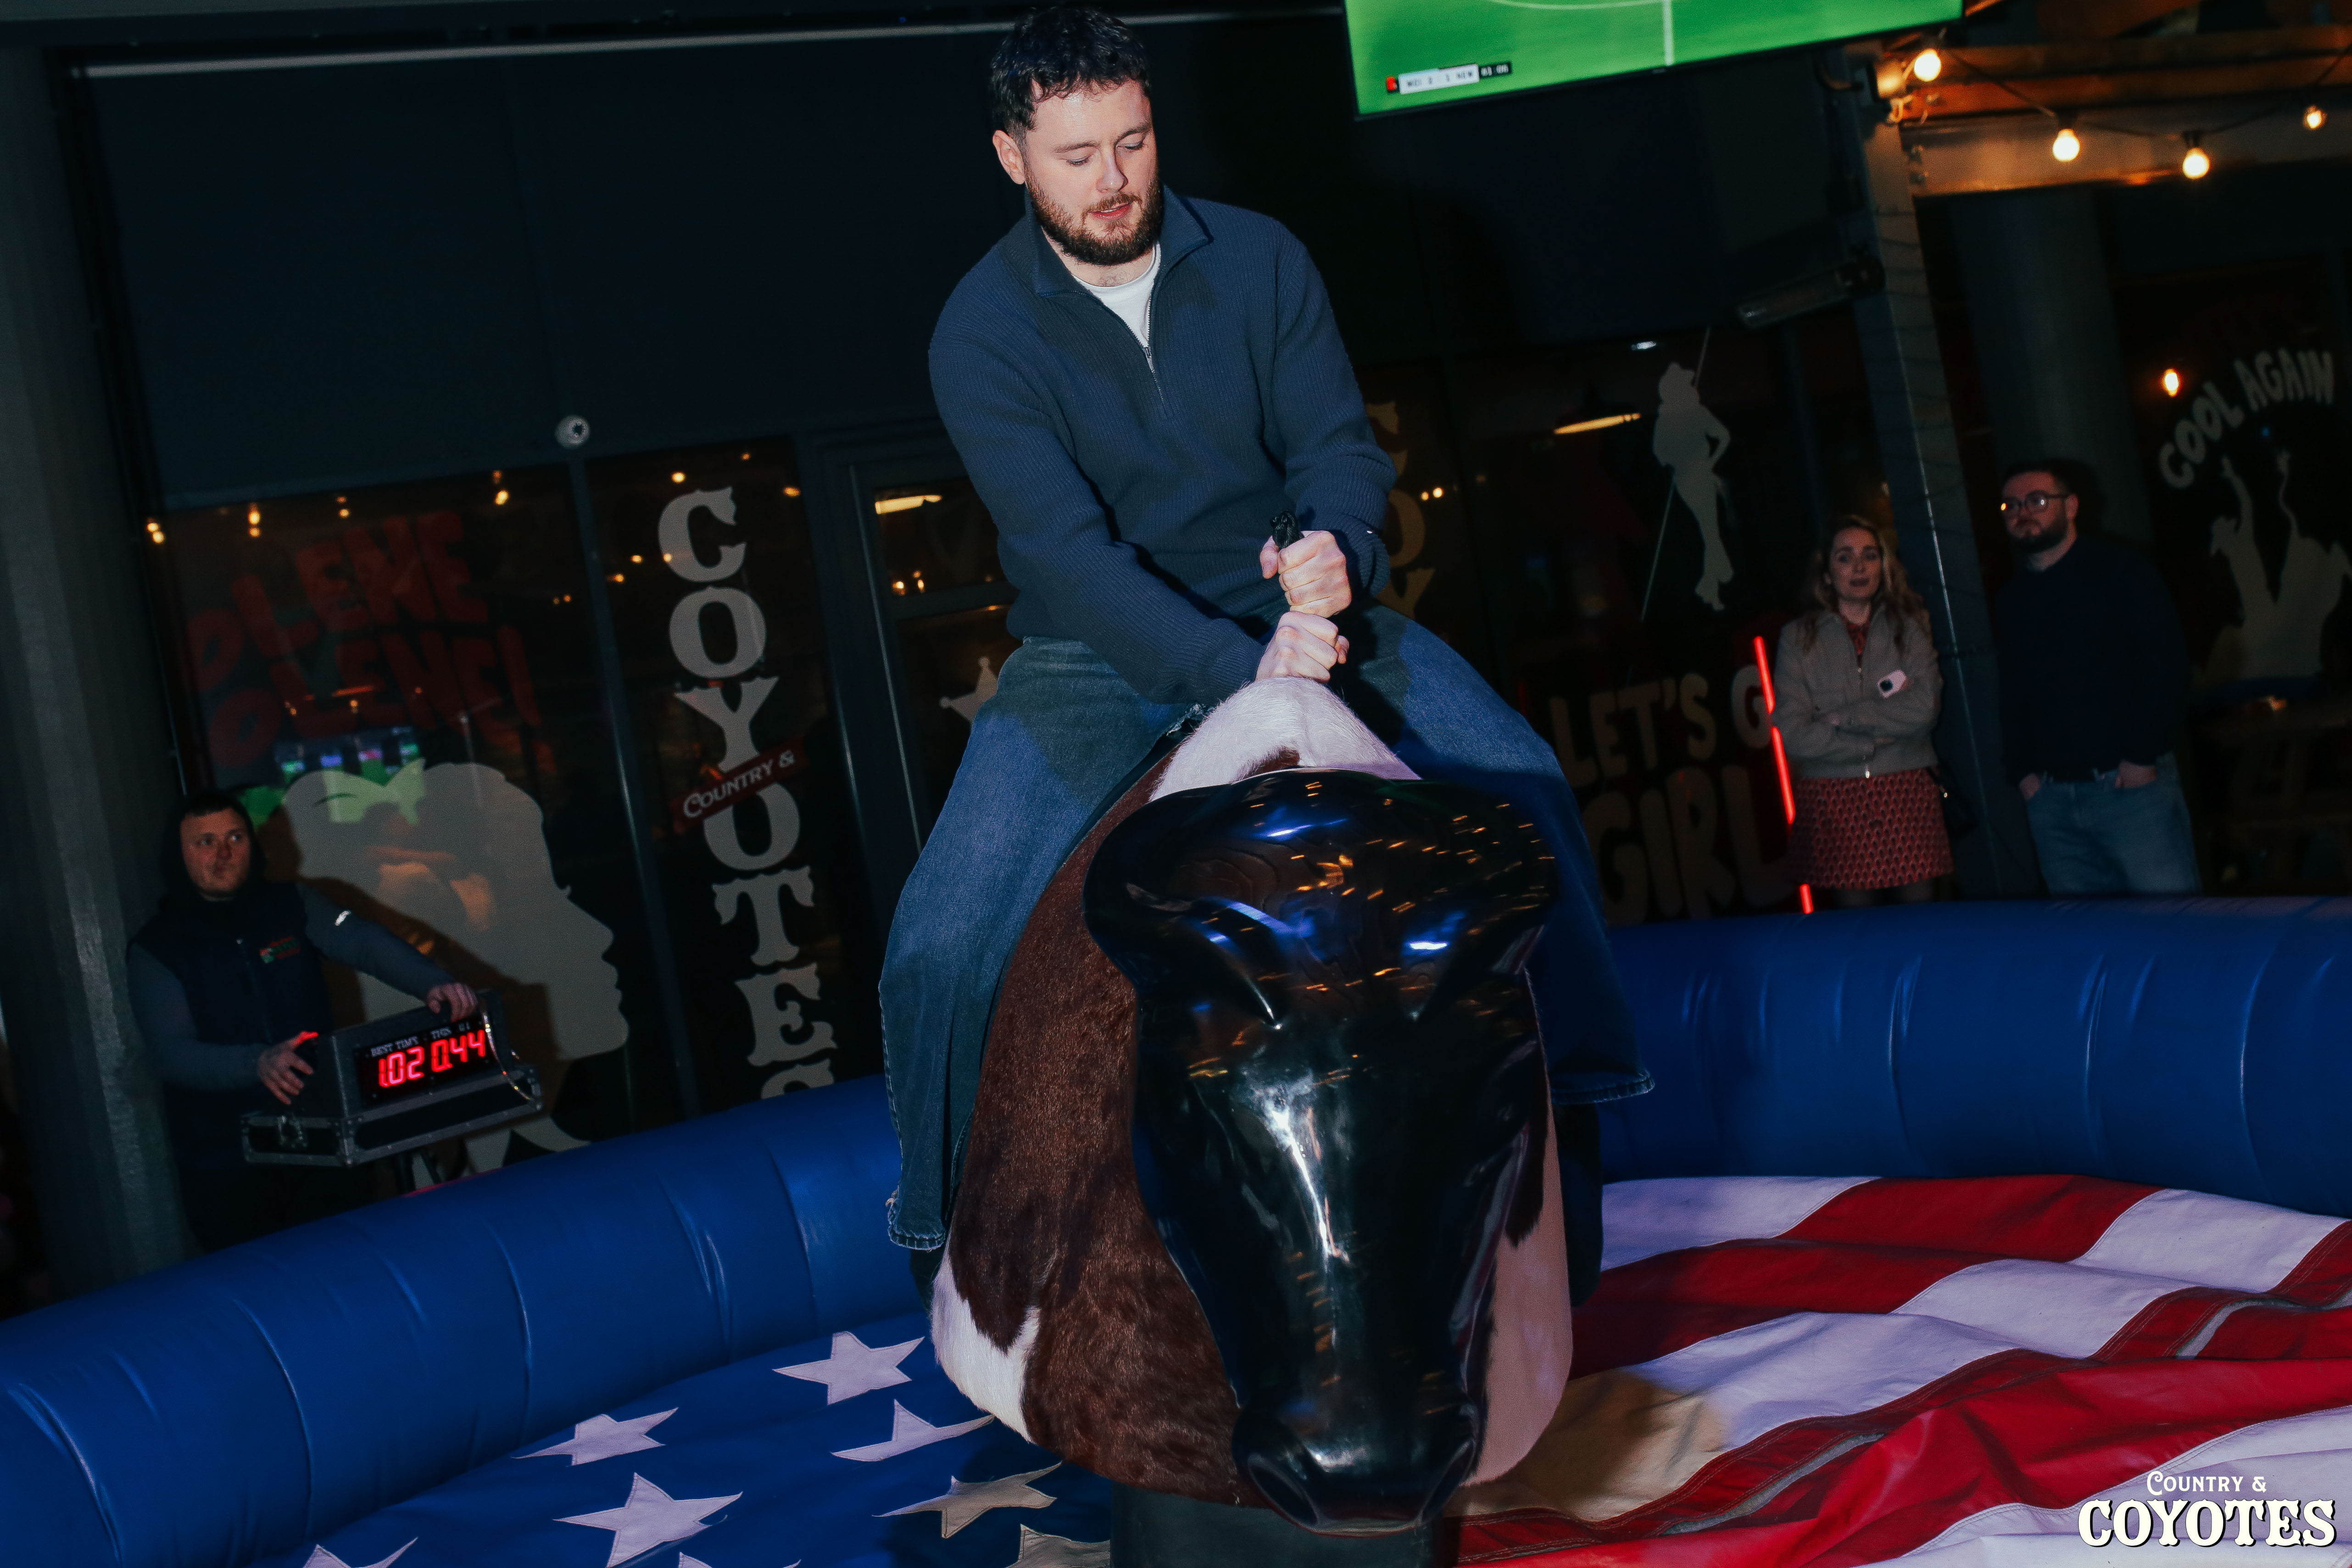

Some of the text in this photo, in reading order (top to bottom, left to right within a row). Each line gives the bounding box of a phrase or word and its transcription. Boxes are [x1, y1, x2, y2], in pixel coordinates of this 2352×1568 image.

[2158, 346, 2335, 490] COOL AGAIN
[777, 749, 796, 769] &
[1548, 672, 1717, 788] LET'S
[371, 1035, 419, 1057] BEST TIME
